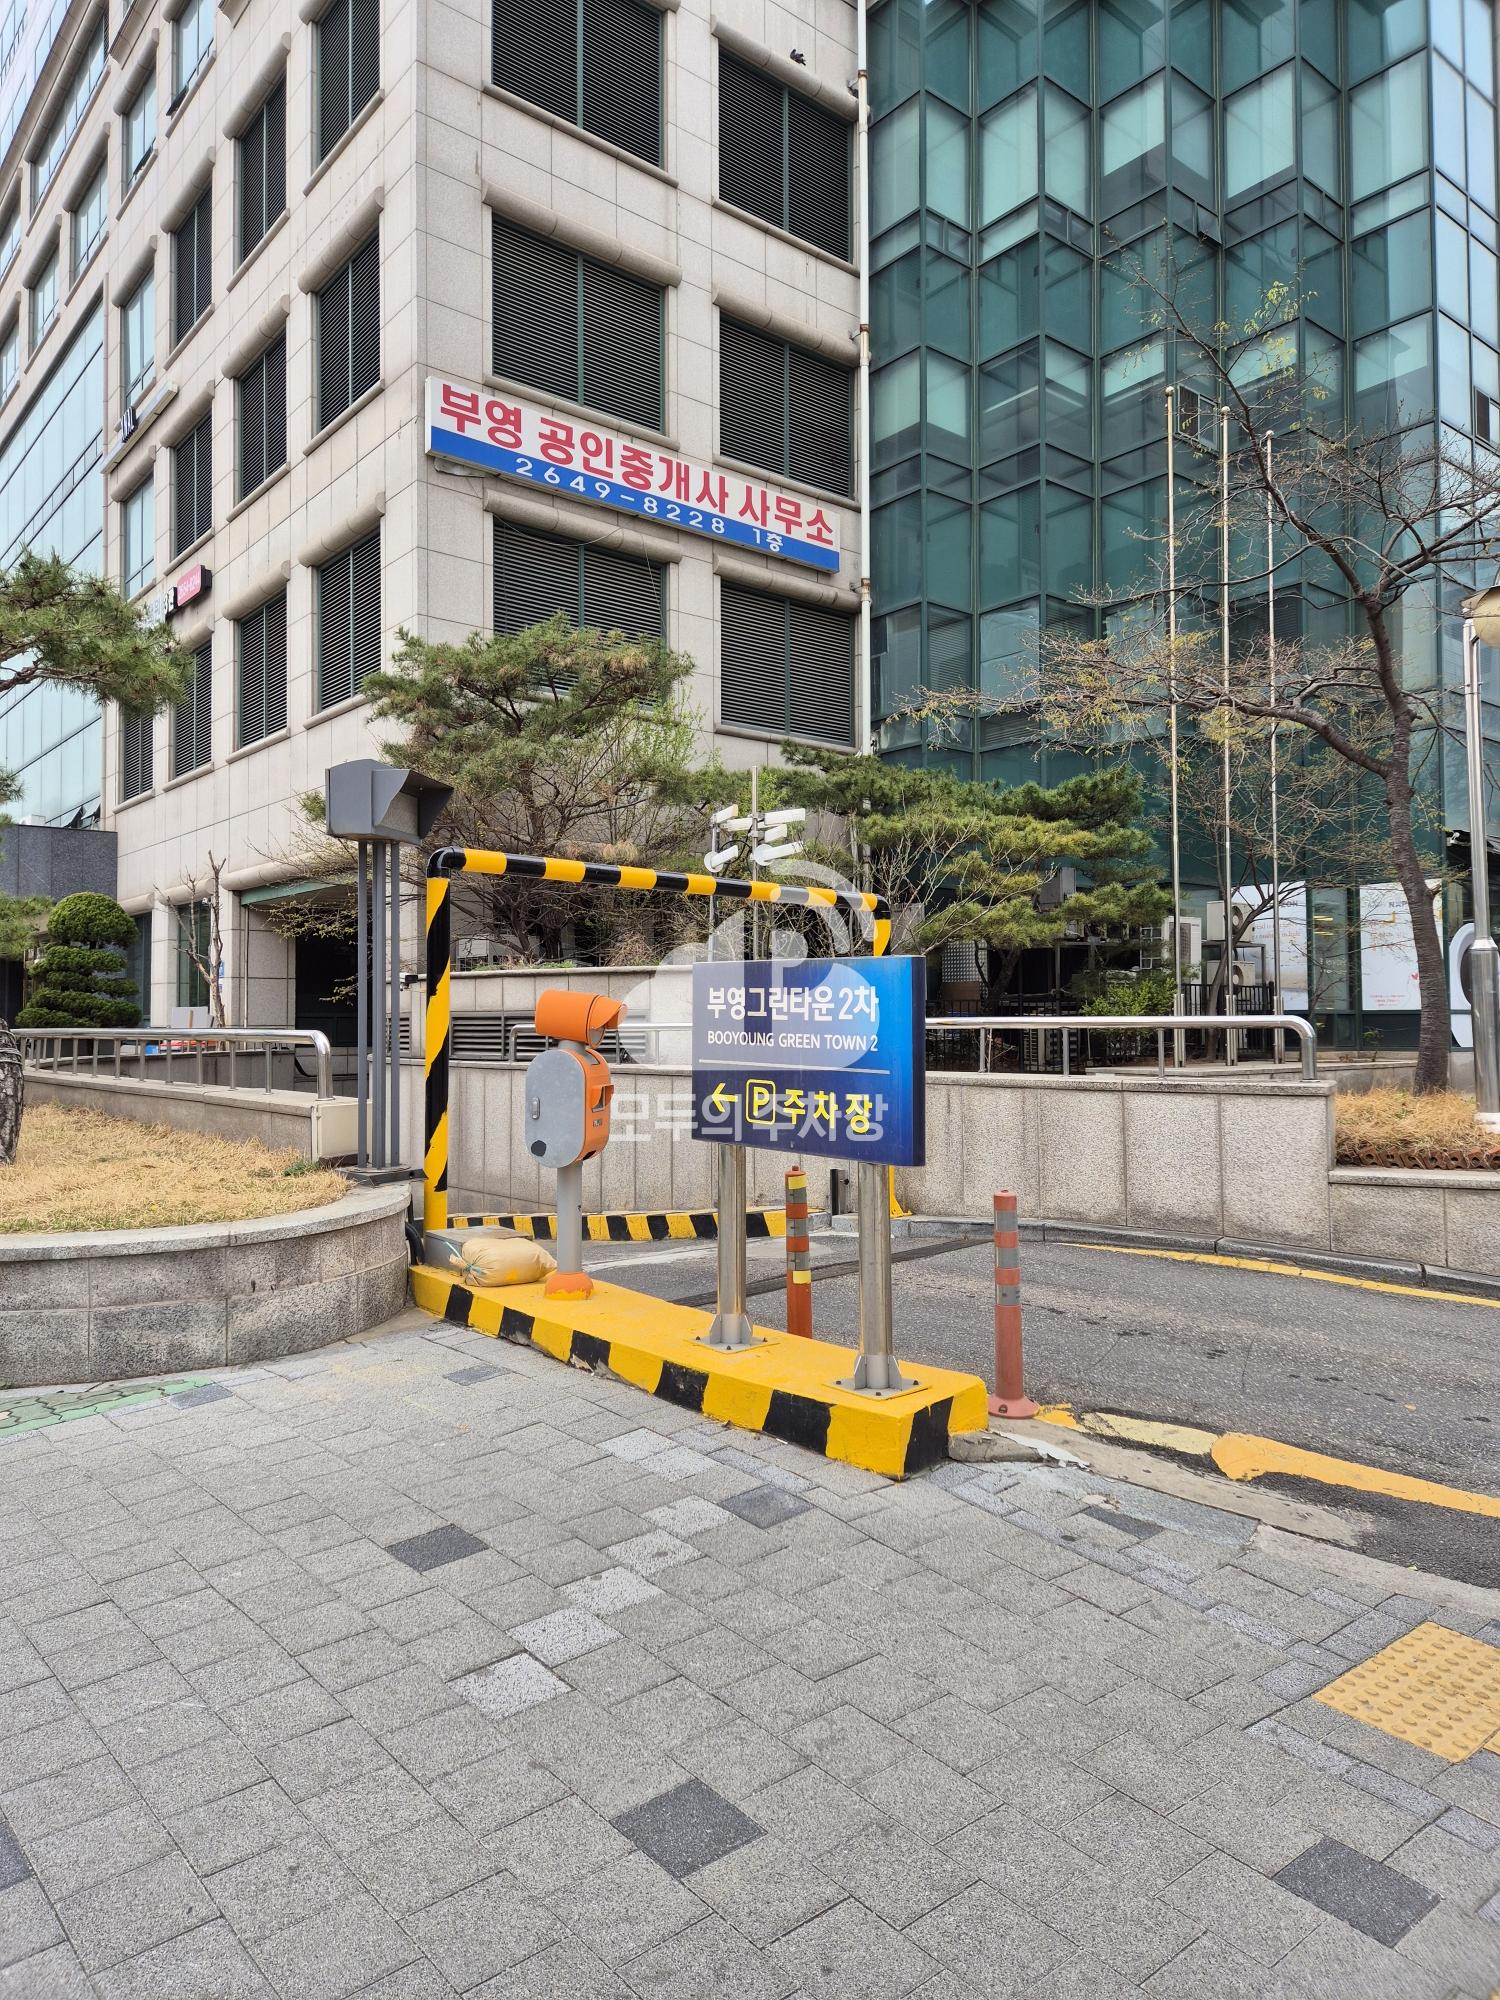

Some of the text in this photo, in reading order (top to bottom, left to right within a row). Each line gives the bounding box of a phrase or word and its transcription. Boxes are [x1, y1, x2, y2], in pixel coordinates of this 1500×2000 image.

[440, 384, 834, 546] 부영 공인중개사 사무소
[515, 457, 784, 552] 2649-8228 1층
[707, 985, 879, 1022] 부영그린타운 2차
[707, 1030, 878, 1051] BOOYOUNG GREEN TOWN 2
[783, 1088, 872, 1133] 주차장
